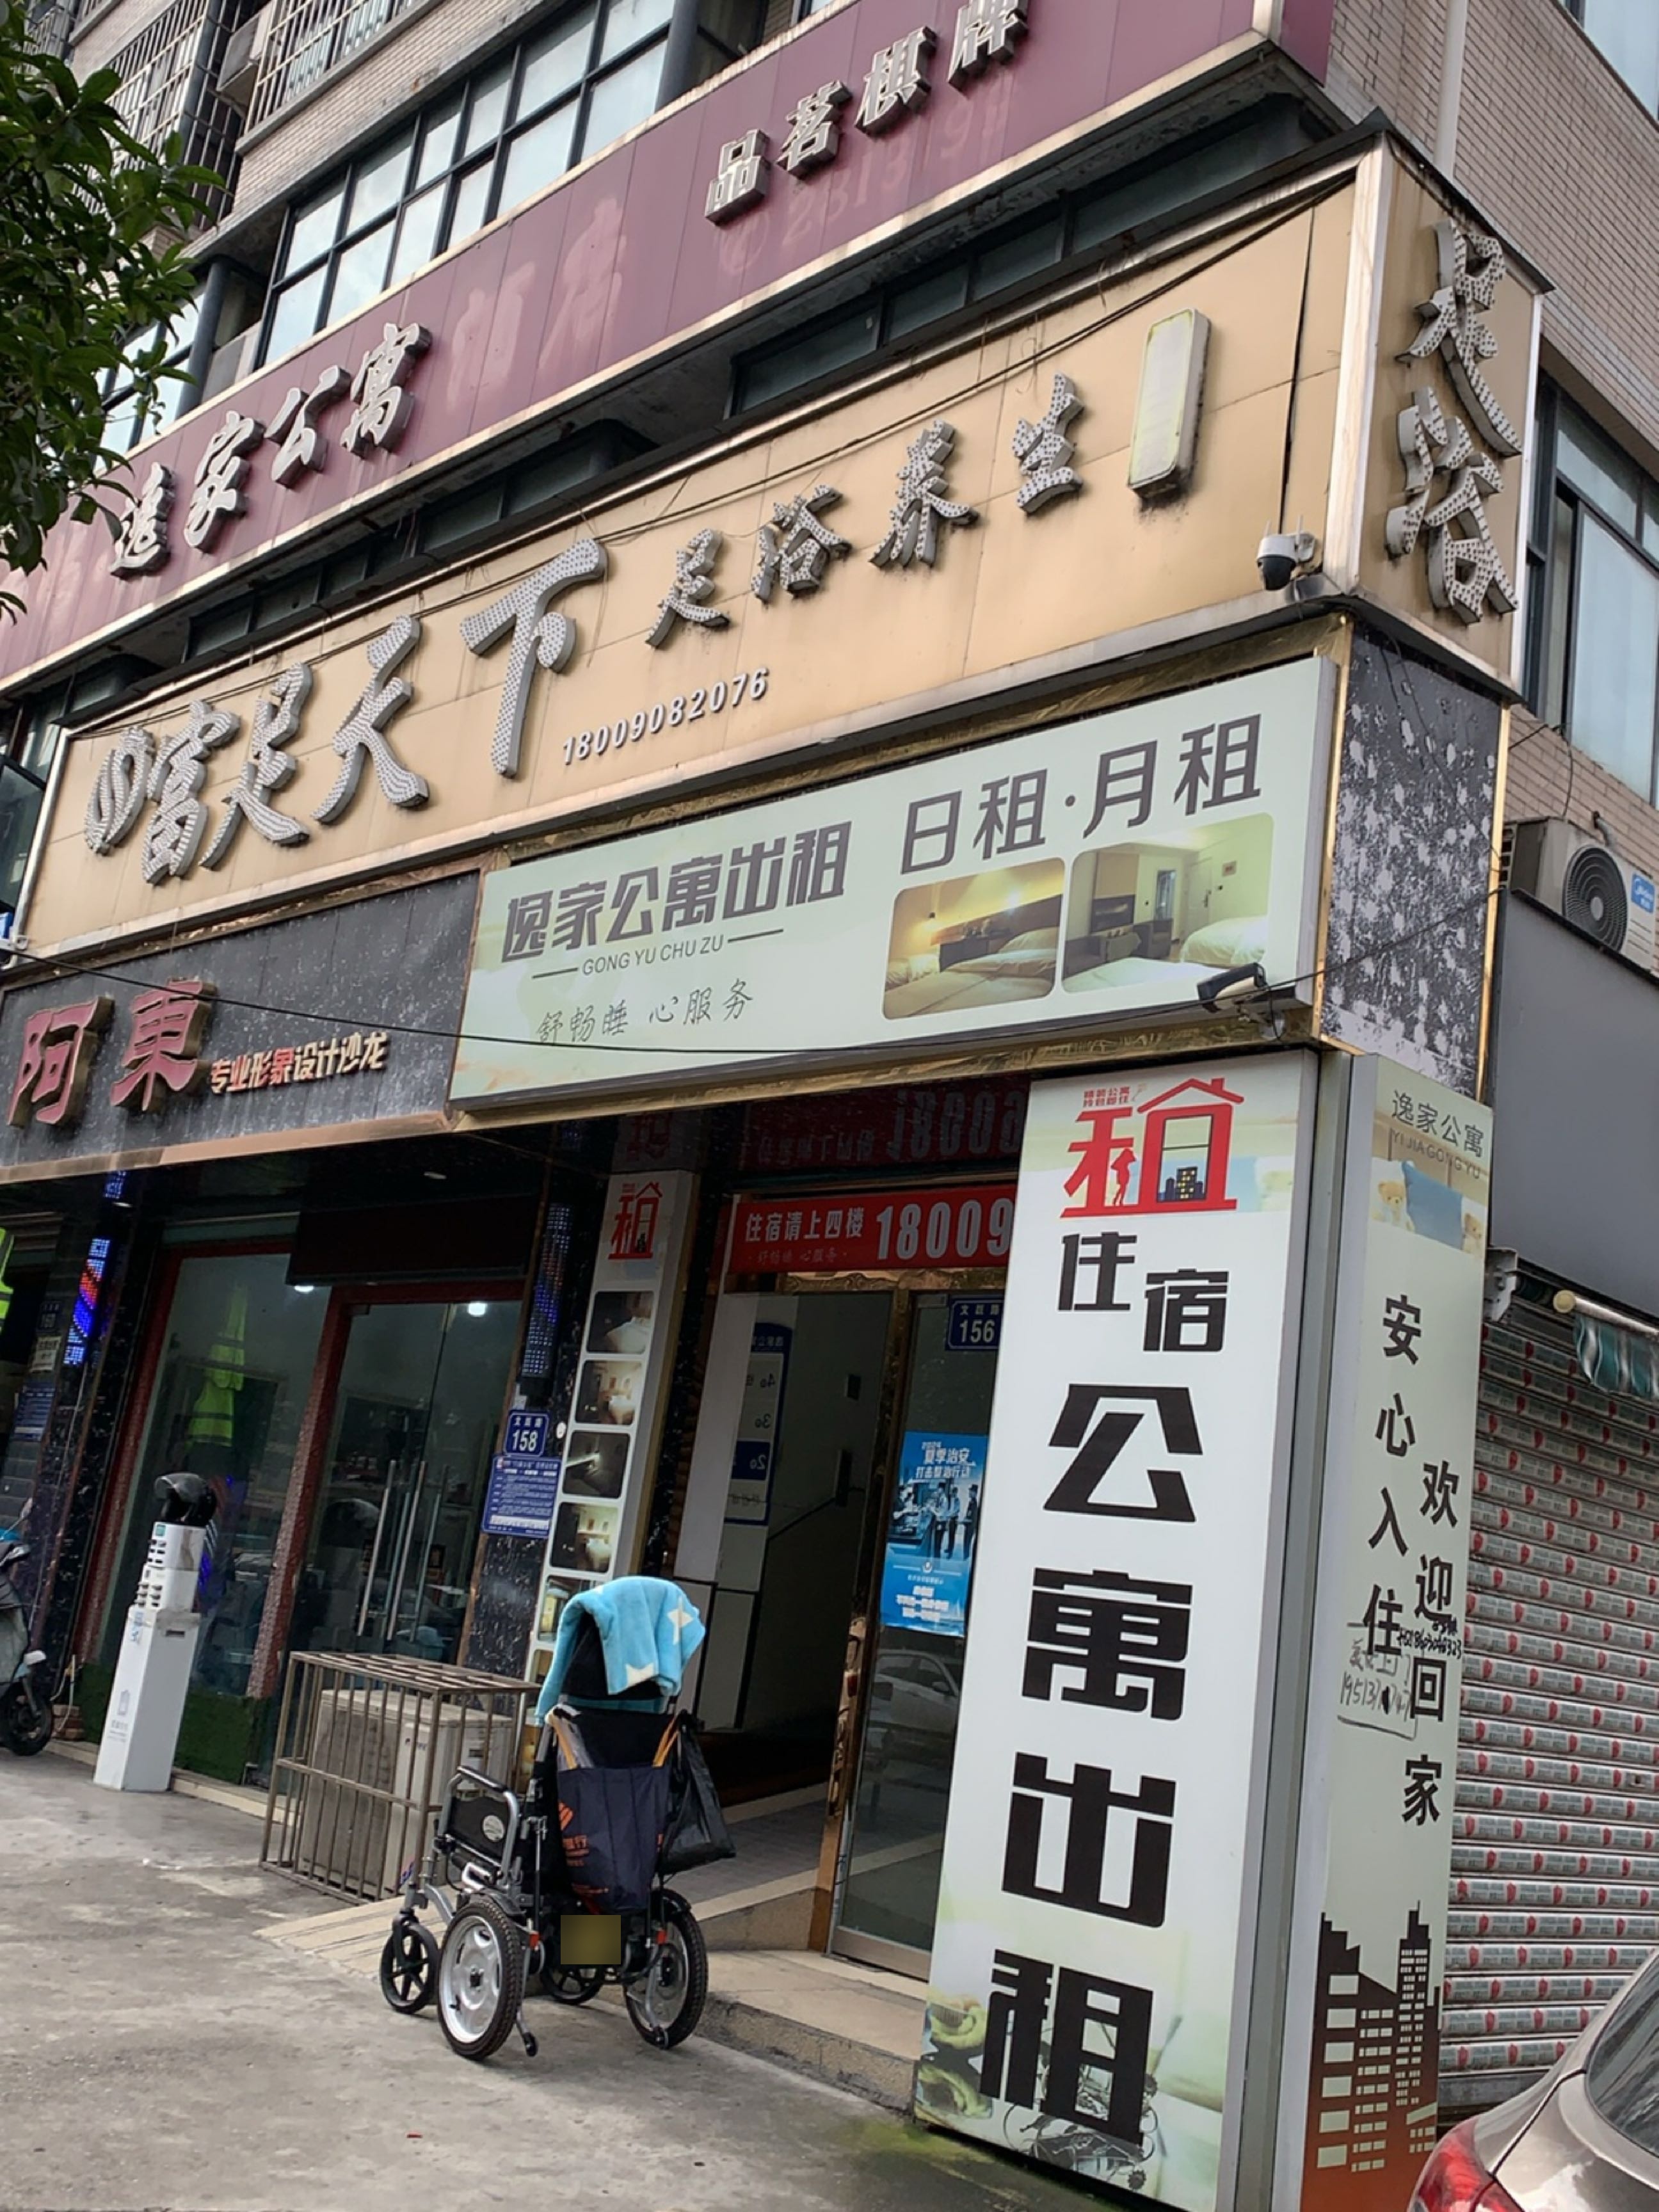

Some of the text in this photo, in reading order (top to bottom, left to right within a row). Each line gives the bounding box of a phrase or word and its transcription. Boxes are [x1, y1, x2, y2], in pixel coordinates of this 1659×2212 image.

[705, 0, 1027, 224] 品茗棋牌
[561, 668, 769, 765] 18009082076
[901, 714, 1261, 874] 日租·月租
[501, 820, 852, 963] 逸家公寓出租
[582, 934, 725, 976] GONG YU CHU ZU
[210, 1031, 390, 1095] 专业形象设计沙龙
[1391, 1089, 1484, 1157] 逸家公寓
[1060, 1077, 1244, 1218] 租
[745, 1198, 1014, 1262] 住宿请上四楼 18009
[959, 1318, 996, 1343] 156
[1058, 1231, 1229, 1352] 住宿
[512, 1429, 538, 1452] 158
[1362, 1294, 1422, 1656] 安心入住
[1402, 1461, 1459, 1826] 欢迎回家
[979, 1384, 1203, 2147] 公寓出租
